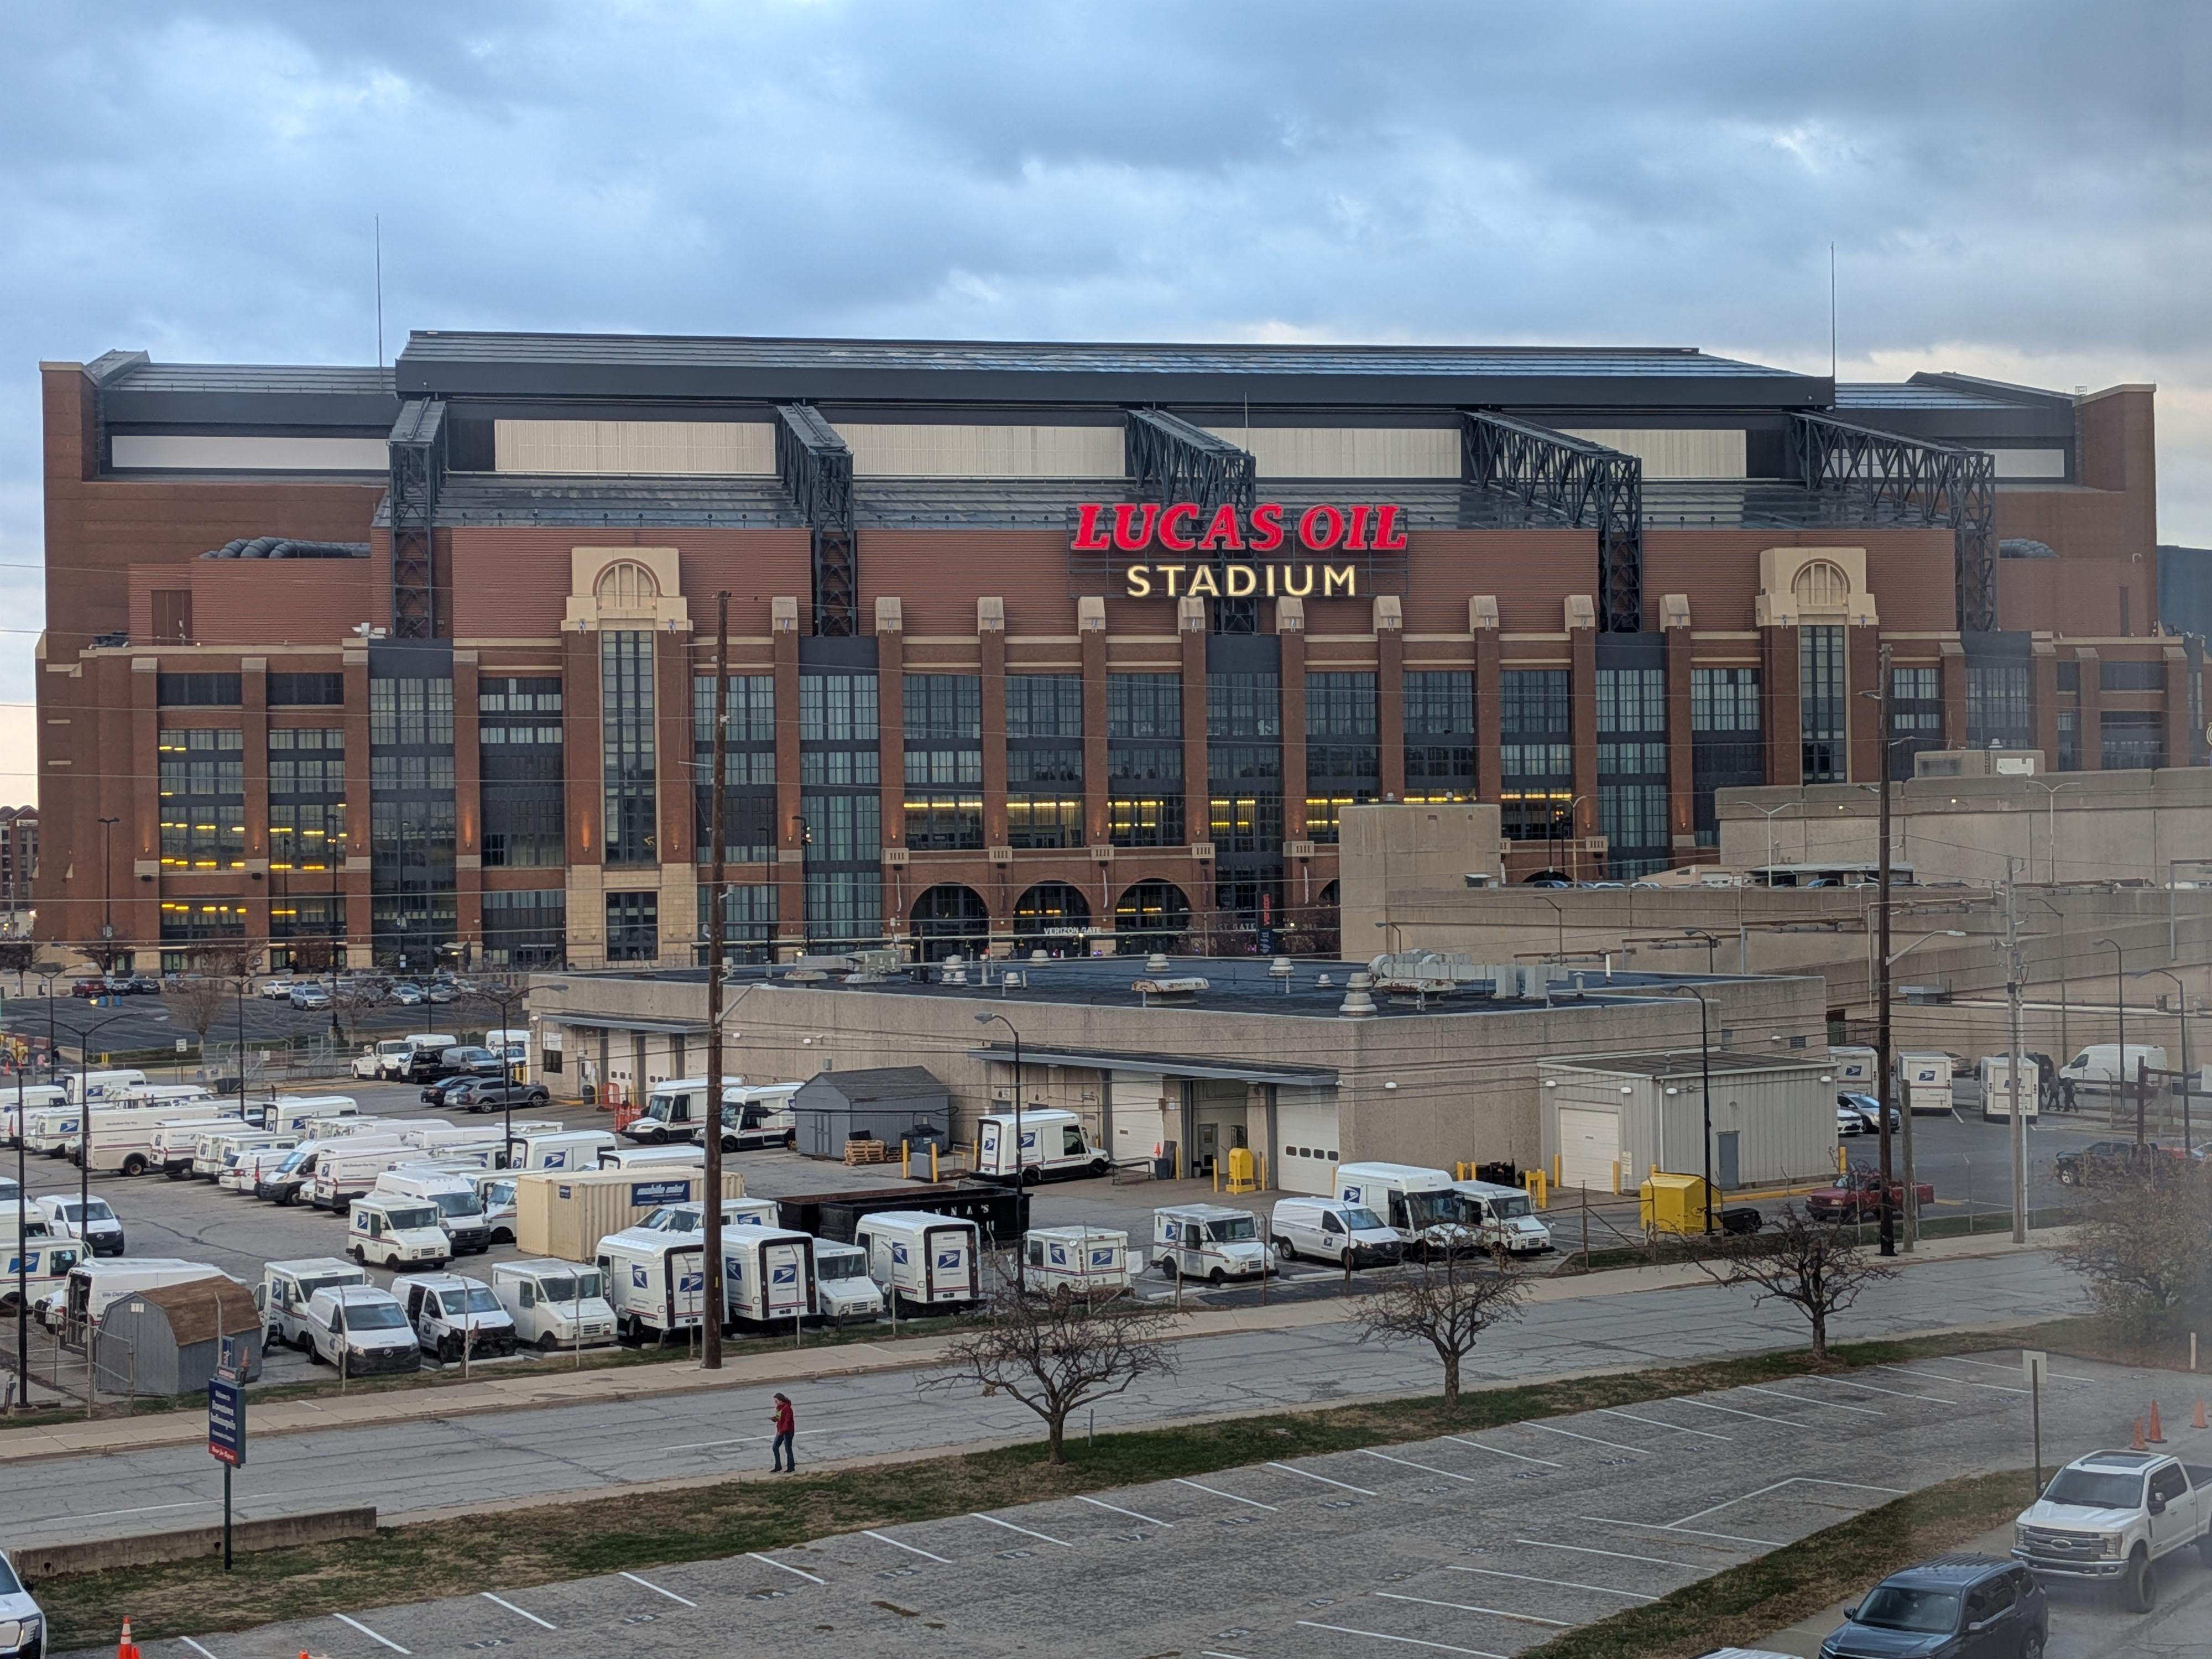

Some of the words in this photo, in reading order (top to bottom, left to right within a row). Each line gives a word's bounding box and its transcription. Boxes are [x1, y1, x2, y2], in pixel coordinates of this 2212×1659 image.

[1071, 503, 1284, 551] LUCAS
[1298, 503, 1408, 551] OIL
[1126, 564, 1356, 598] STADIUM
[1044, 926, 1078, 935] VERIZON
